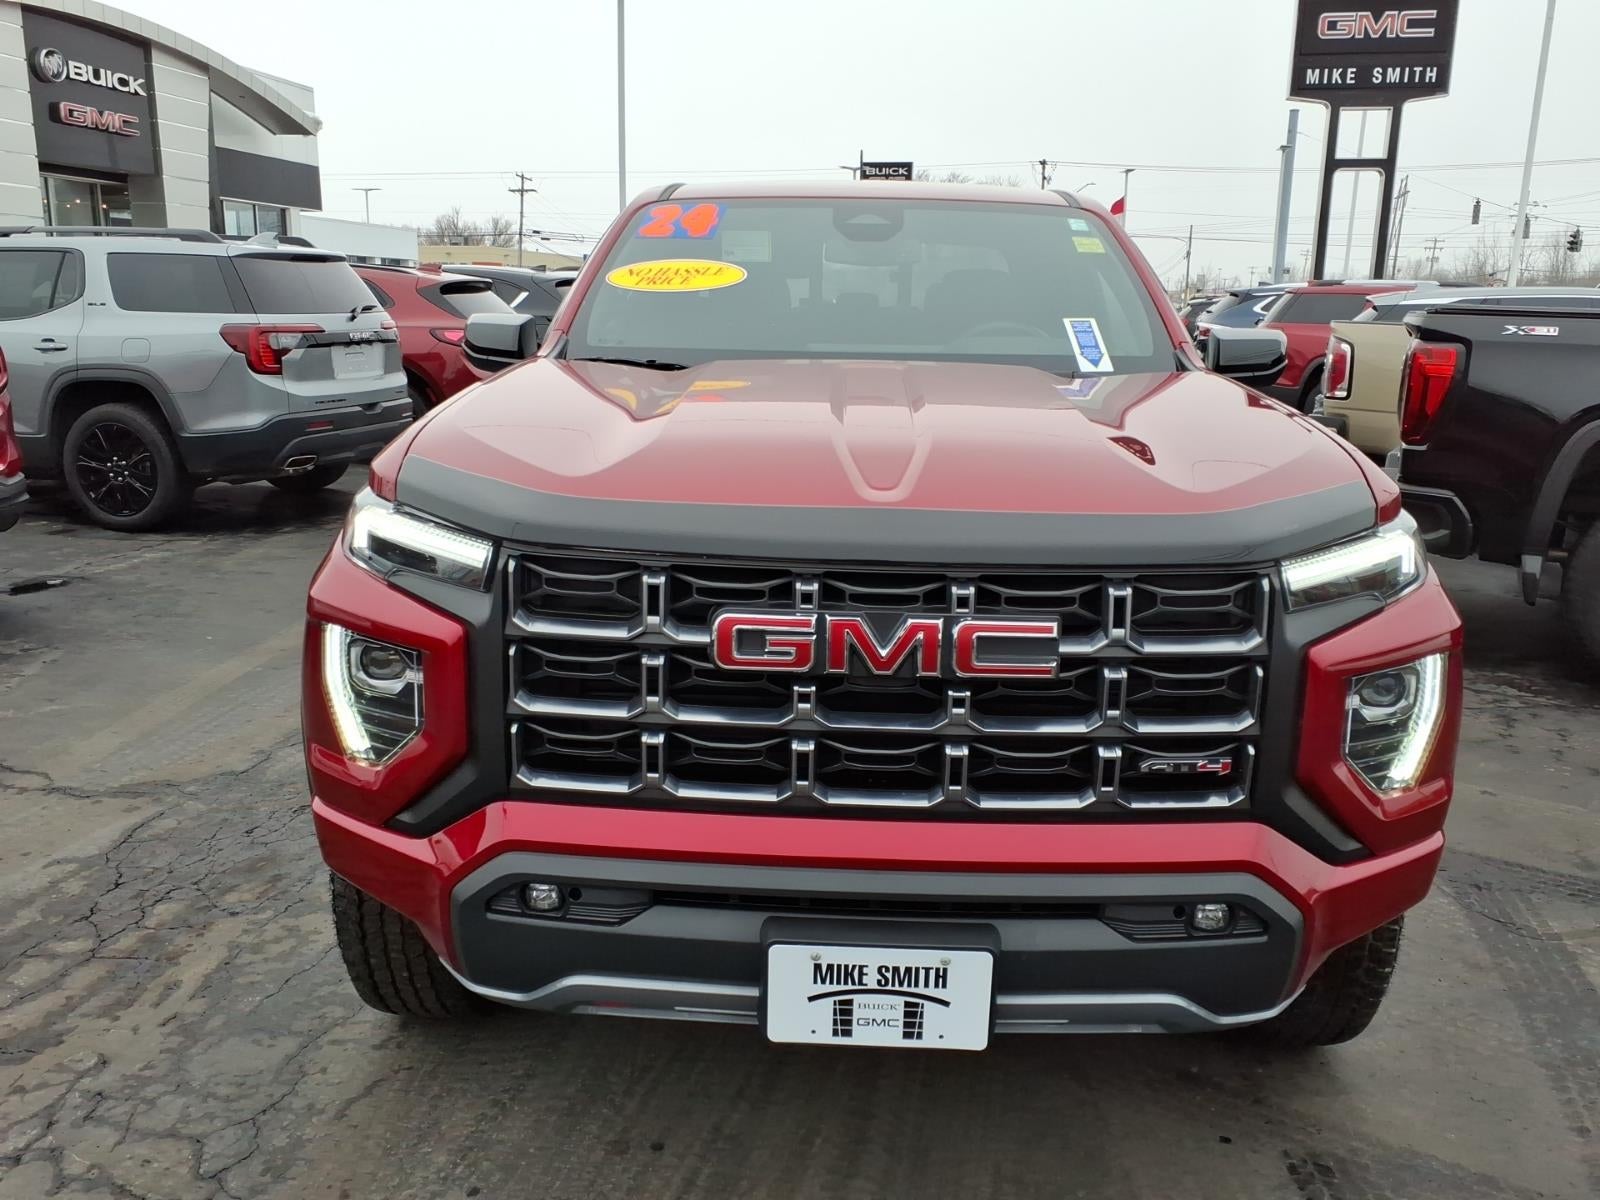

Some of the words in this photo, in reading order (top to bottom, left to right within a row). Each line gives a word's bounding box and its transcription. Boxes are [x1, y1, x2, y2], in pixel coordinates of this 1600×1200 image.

[1317, 10, 1437, 39] GMC
[67, 60, 147, 96] BUICK
[1305, 68, 1357, 84] MIKE
[1372, 66, 1437, 84] SMITH
[59, 101, 140, 136] GMC
[866, 167, 908, 175] BUICK
[638, 203, 719, 238] 24
[713, 613, 1058, 678] GMC
[813, 963, 869, 987] MIKE
[876, 964, 948, 989] SMITH
[857, 1001, 899, 1011] BUICK
[856, 1017, 900, 1028] GMC
